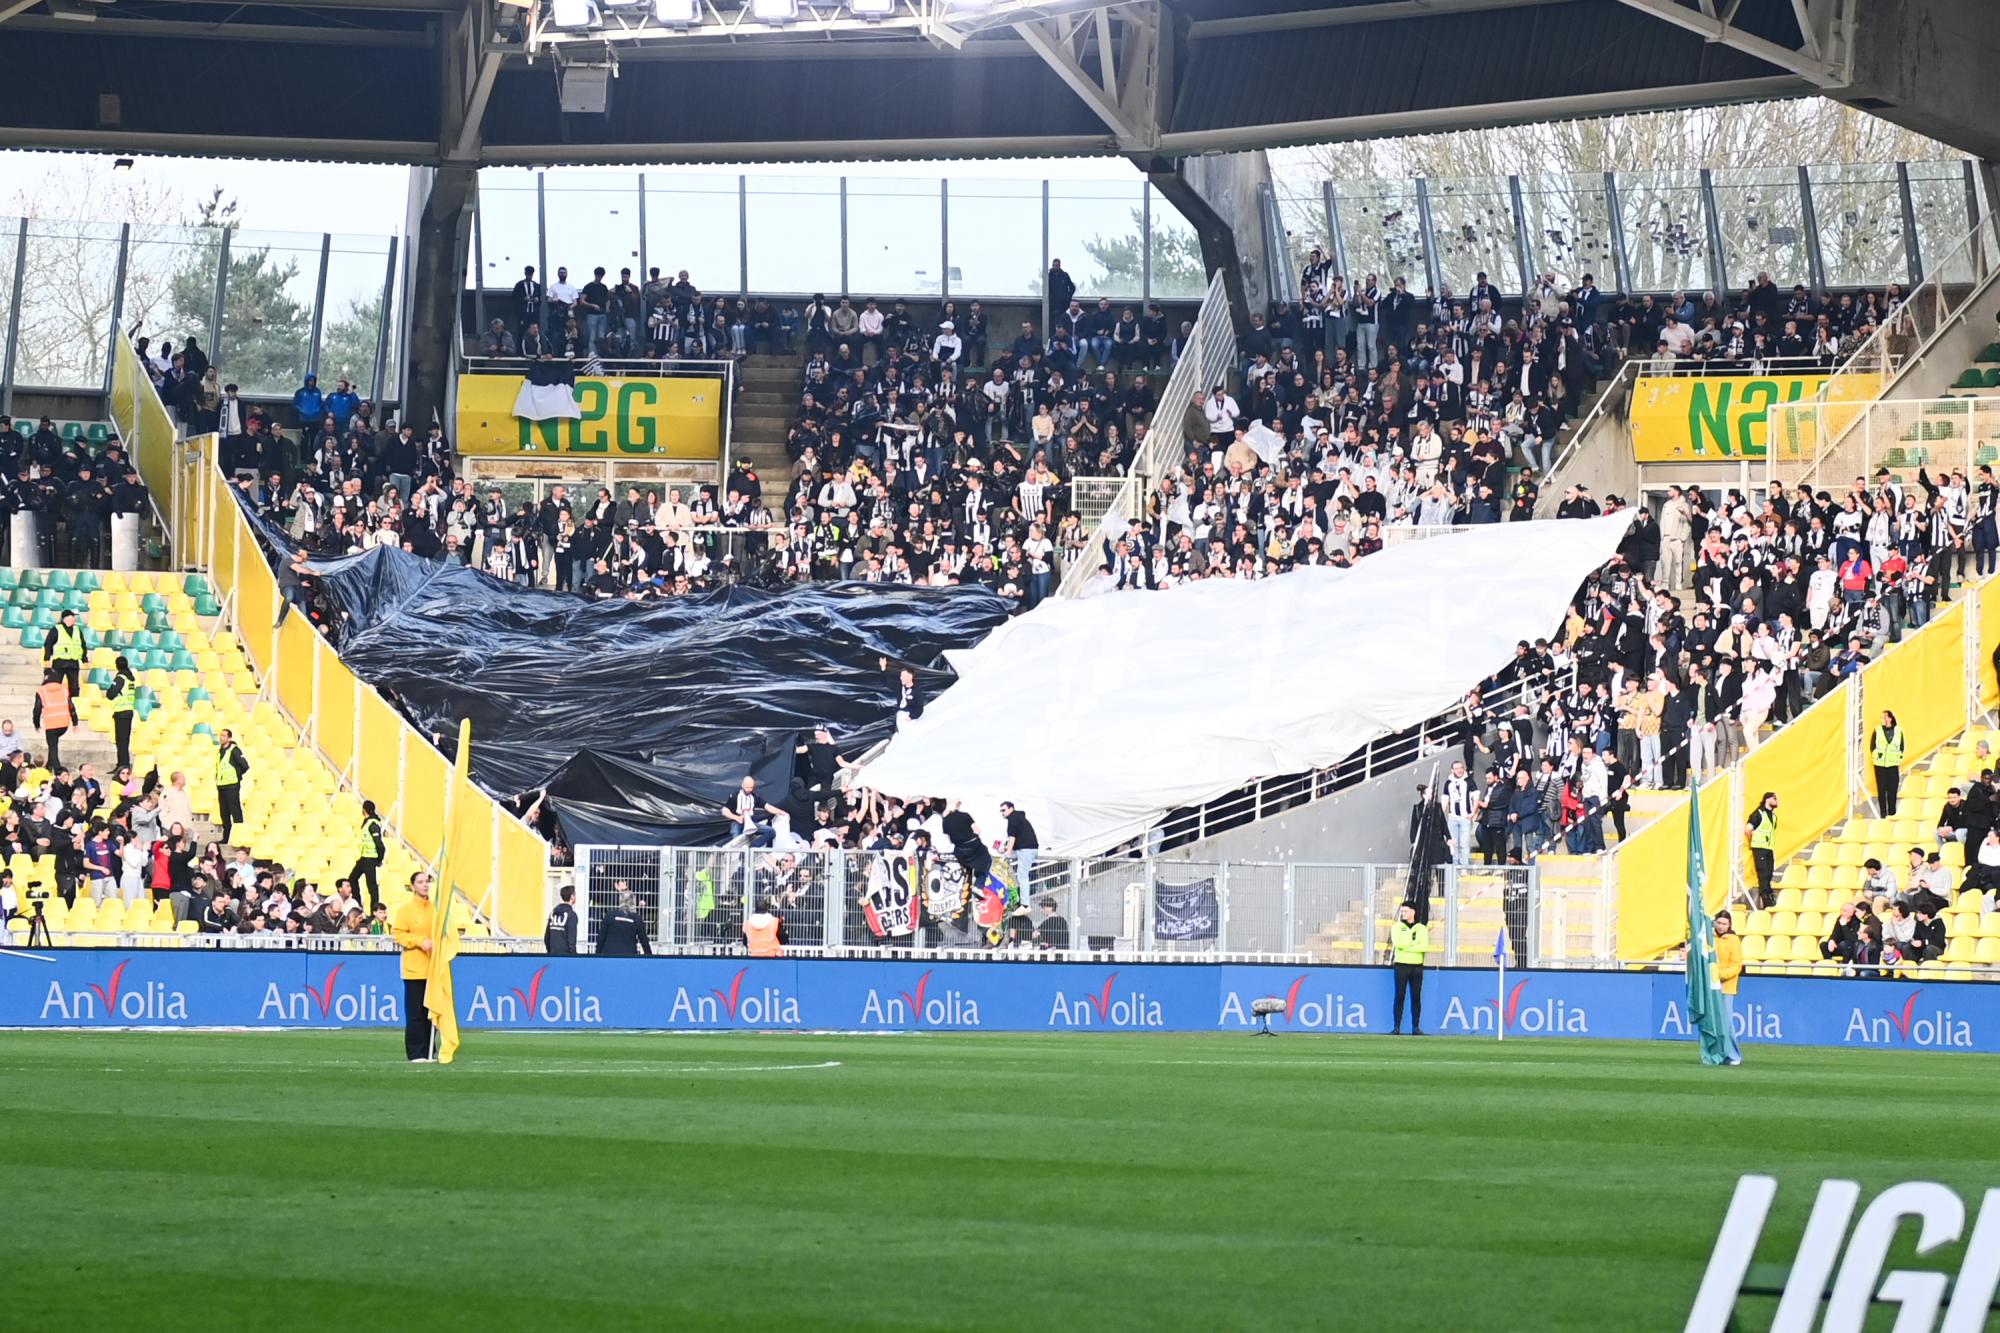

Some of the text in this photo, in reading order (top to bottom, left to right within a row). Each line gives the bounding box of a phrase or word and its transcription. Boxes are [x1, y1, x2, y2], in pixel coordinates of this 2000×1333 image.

[40, 961, 188, 1020] AnVolia
[258, 962, 400, 1022] AnVolia
[466, 965, 603, 1023] AnVolia
[668, 967, 802, 1024] AnVolia
[860, 971, 981, 1025] AnVolia
[1049, 973, 1164, 1026] AnVolia
[1440, 978, 1589, 1033] AnVolia
[1844, 988, 1973, 1047] AnVolia
[1660, 1000, 1783, 1039] Aolia
